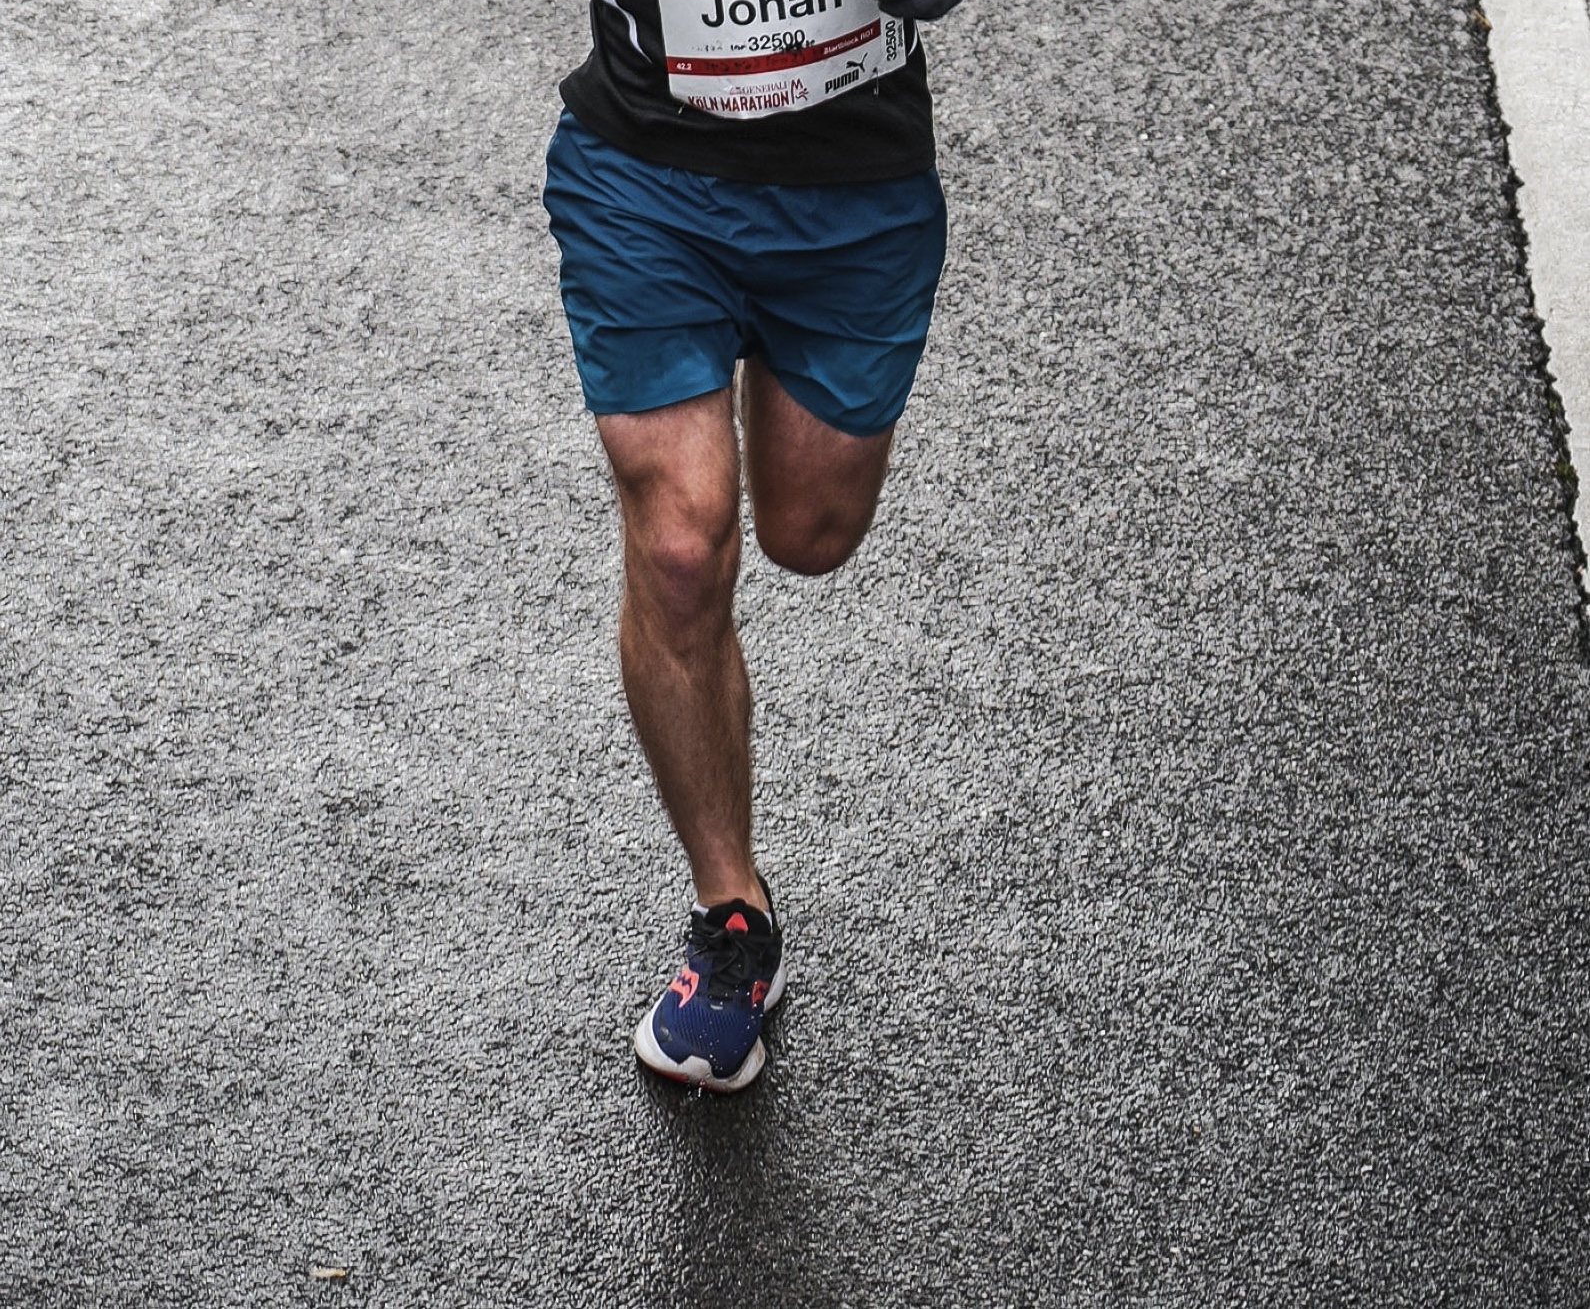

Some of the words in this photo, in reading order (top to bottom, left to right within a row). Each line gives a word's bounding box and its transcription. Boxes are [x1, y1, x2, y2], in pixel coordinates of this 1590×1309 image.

[748, 29, 806, 52] 32500
[886, 20, 897, 62] 32500
[742, 80, 788, 94] GENERALI
[825, 68, 860, 94] PUMA
[720, 91, 790, 112] MARATHON
